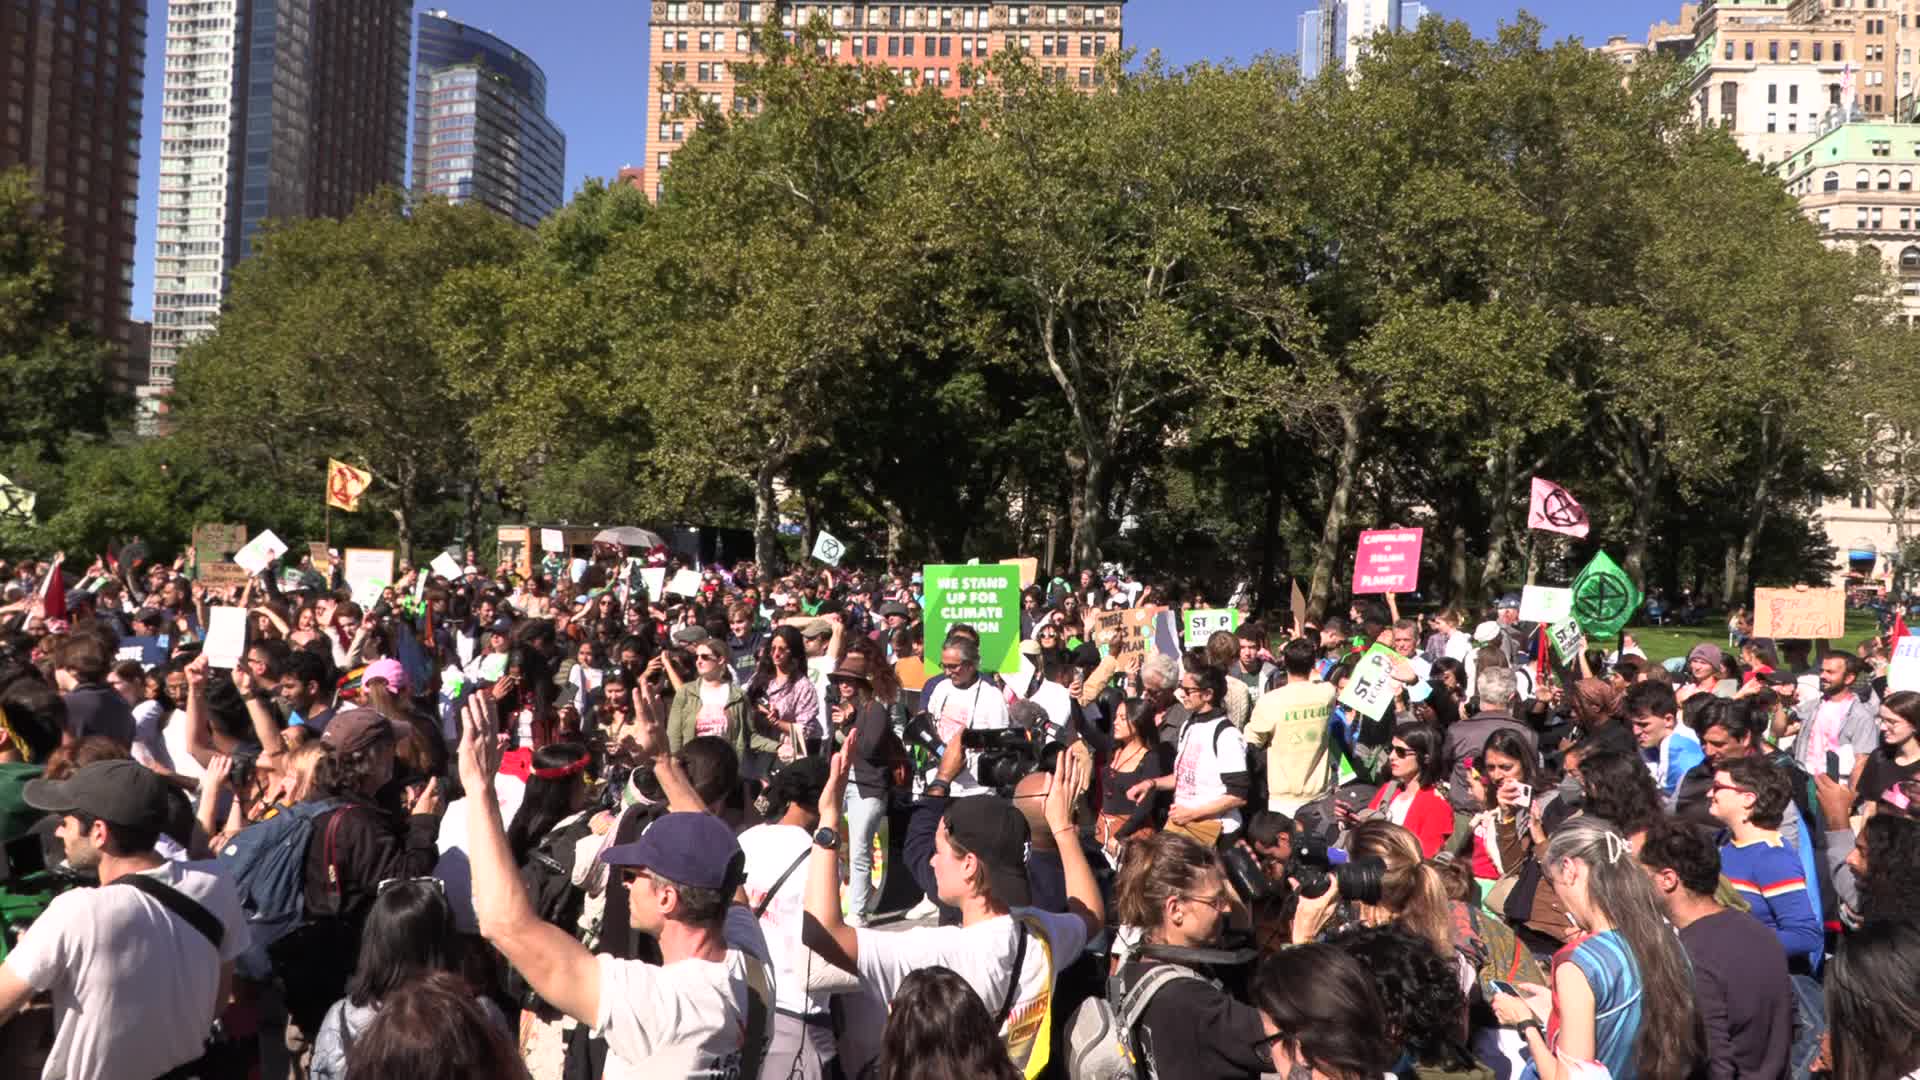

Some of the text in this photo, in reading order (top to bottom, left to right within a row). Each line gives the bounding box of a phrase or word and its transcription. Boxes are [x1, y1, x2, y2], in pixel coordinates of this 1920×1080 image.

[937, 577, 1009, 590] WE STAND
[1360, 575, 1406, 586] PLANET
[946, 592, 998, 605] UP FOR
[940, 607, 1004, 619] CLIMATE
[944, 621, 1000, 633] AION
[1192, 615, 1229, 628] STP
[1555, 620, 1577, 643] STP
[1354, 655, 1383, 699] STP
